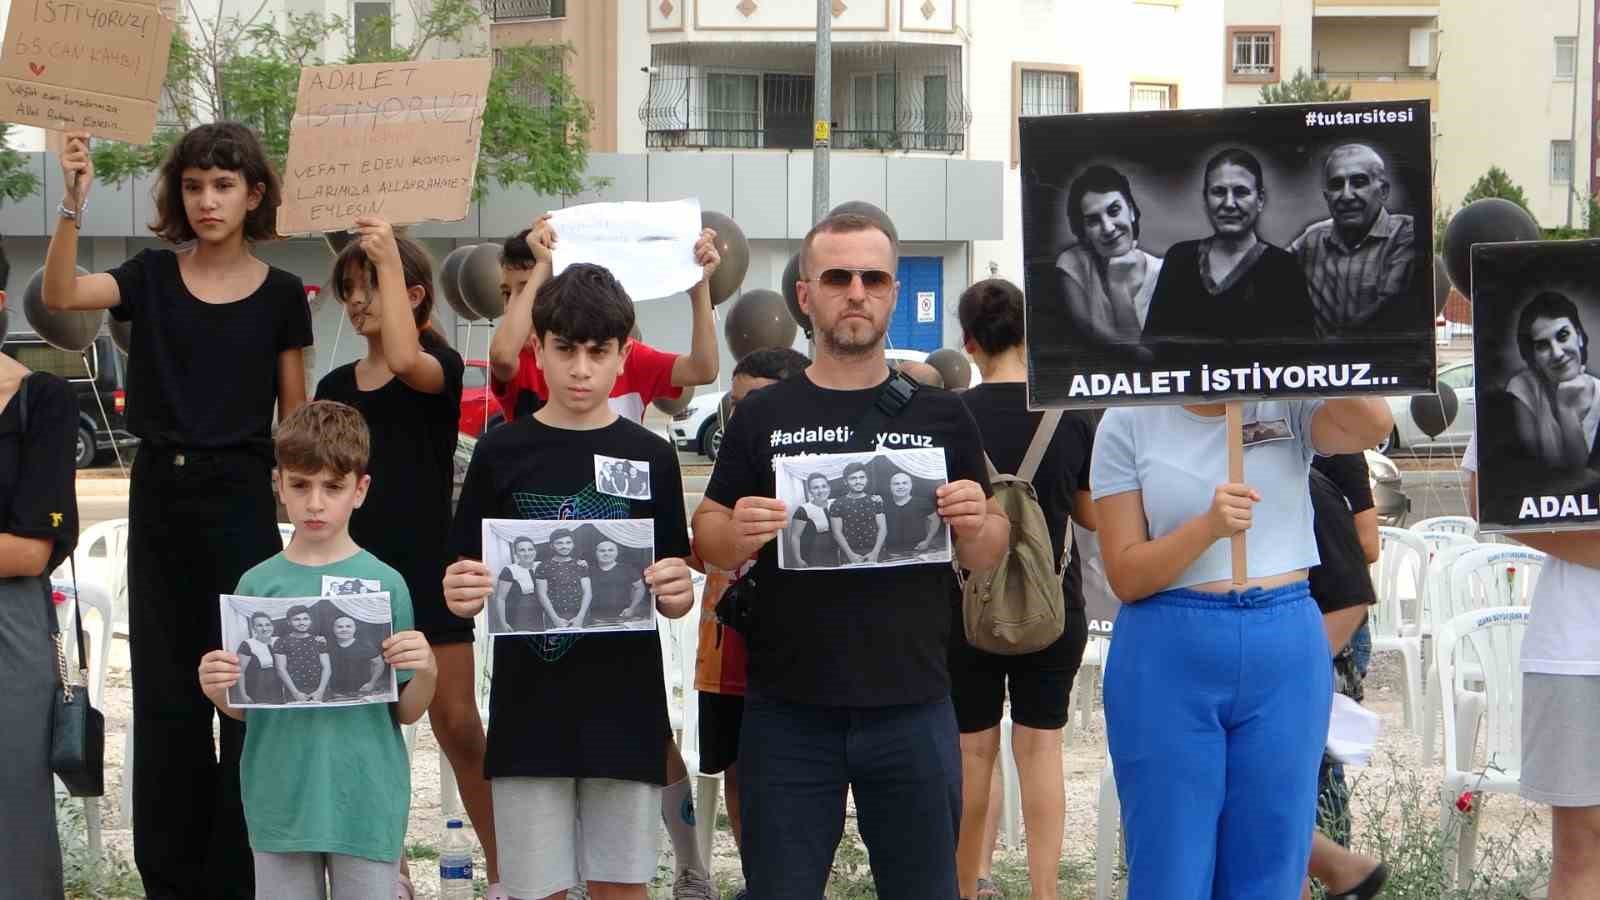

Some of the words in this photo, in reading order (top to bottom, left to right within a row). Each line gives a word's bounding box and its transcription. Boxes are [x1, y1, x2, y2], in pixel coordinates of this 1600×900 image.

[311, 68, 416, 89] ADALET
[1305, 108, 1413, 127] #tutarsitesi
[361, 158, 404, 175] EDEN
[1068, 371, 1191, 397] ADALET
[1201, 362, 1399, 393] İSTİYORUZ...
[1518, 494, 1600, 520] ADAL
